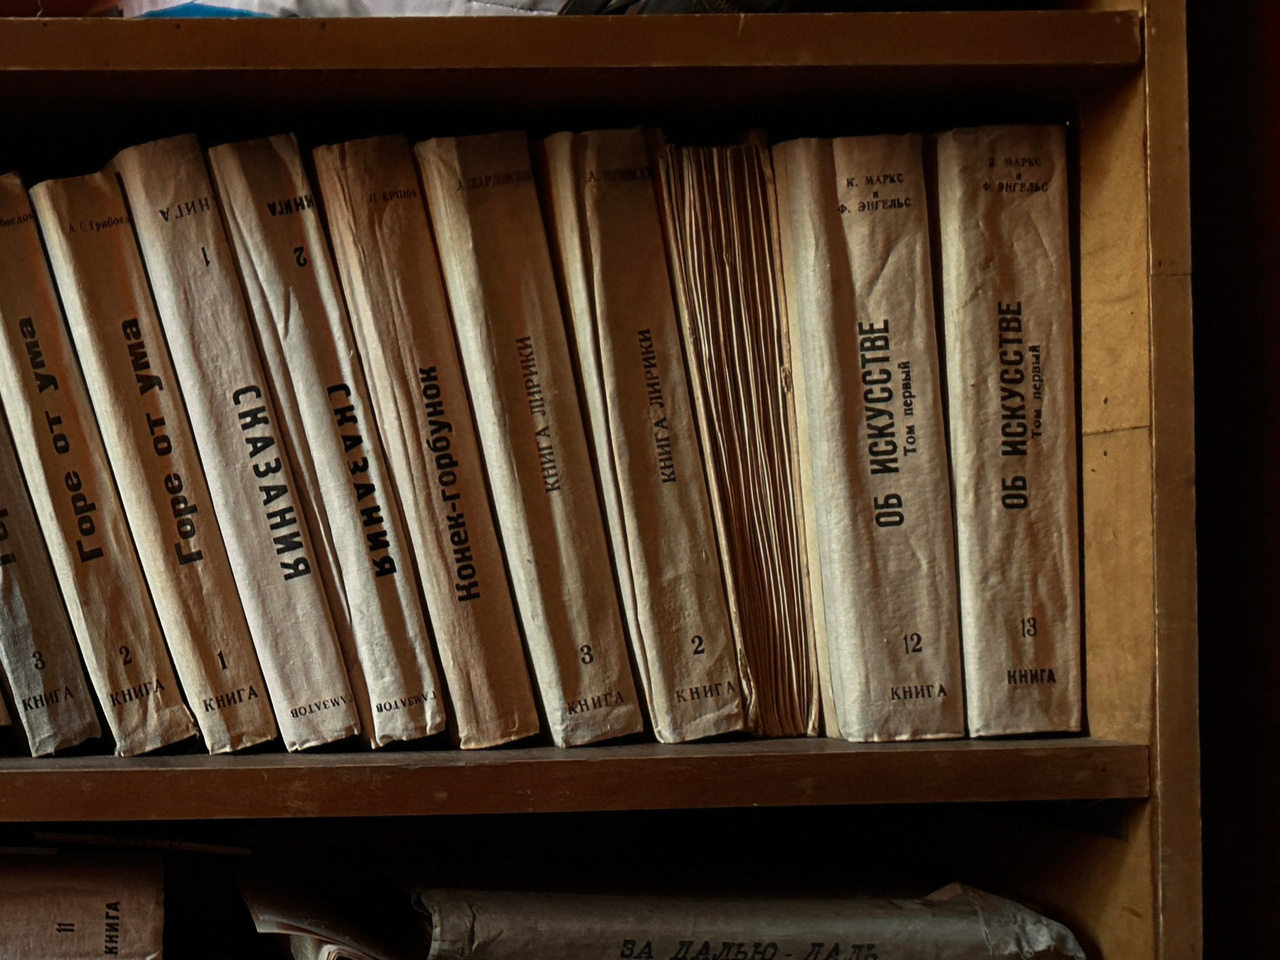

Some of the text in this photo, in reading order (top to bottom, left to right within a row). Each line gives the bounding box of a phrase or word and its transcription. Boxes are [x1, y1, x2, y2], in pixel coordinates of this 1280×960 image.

[847, 173, 904, 187] К. МАРКС
[837, 196, 911, 215] Ф. ЭНГЕЛЬС
[293, 245, 308, 268] 2
[515, 335, 561, 495] КНИГА ЛИРИКИ
[636, 328, 677, 484] КНИГА ЛИРИКИ
[896, 360, 918, 458] Том первый
[997, 300, 1029, 511] ОБ ИСКУССТВЕ
[858, 318, 906, 528] ОБ ИСКУССТВЕ
[19, 316, 105, 563] Горе от ума
[120, 316, 204, 566] Горе от ума
[232, 384, 312, 581] СКАЗАНИЯ
[326, 382, 398, 579] СКАЗАНИЯ
[419, 364, 481, 603] Конек-горбунок
[1020, 616, 1038, 638] 13
[580, 644, 594, 666] 3
[690, 635, 705, 656] 2
[902, 632, 923, 654] 12
[32, 651, 46, 671] 3
[119, 645, 133, 667] 2
[1007, 667, 1057, 685] КНИГА
[110, 678, 167, 707] КНИГА
[203, 684, 259, 713] КНИГА
[568, 690, 624, 716] КНИГА
[675, 681, 736, 705] КНИГА
[890, 683, 948, 702] КНИГА
[54, 922, 76, 934] 11
[104, 900, 121, 956] КНИГА
[620, 938, 654, 960] ЗА
